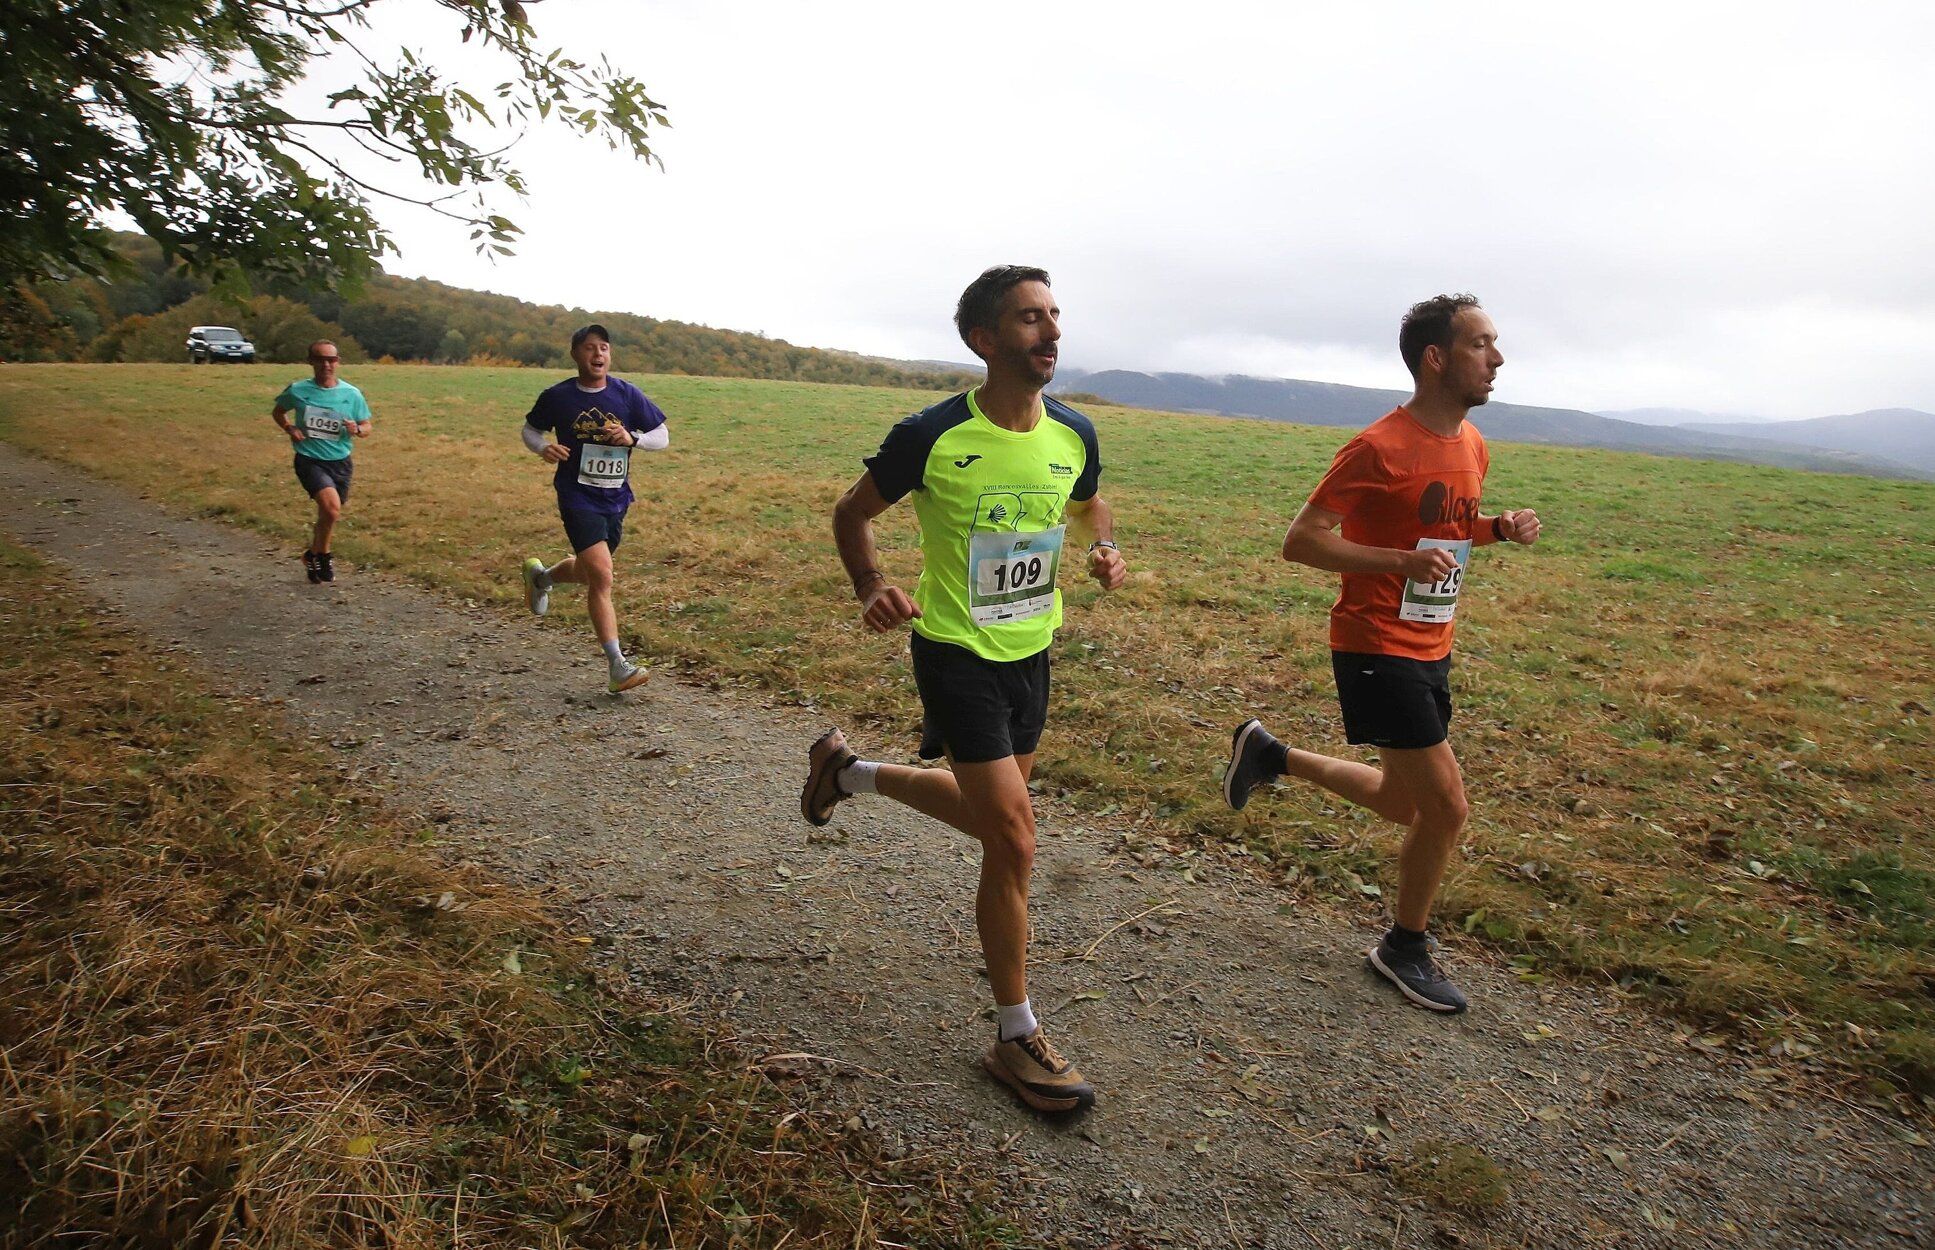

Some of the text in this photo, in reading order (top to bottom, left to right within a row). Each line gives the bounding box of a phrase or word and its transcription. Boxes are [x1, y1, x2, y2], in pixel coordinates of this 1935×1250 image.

[309, 417, 339, 431] 1049
[587, 459, 623, 474] 1018
[994, 557, 1042, 592] 109
